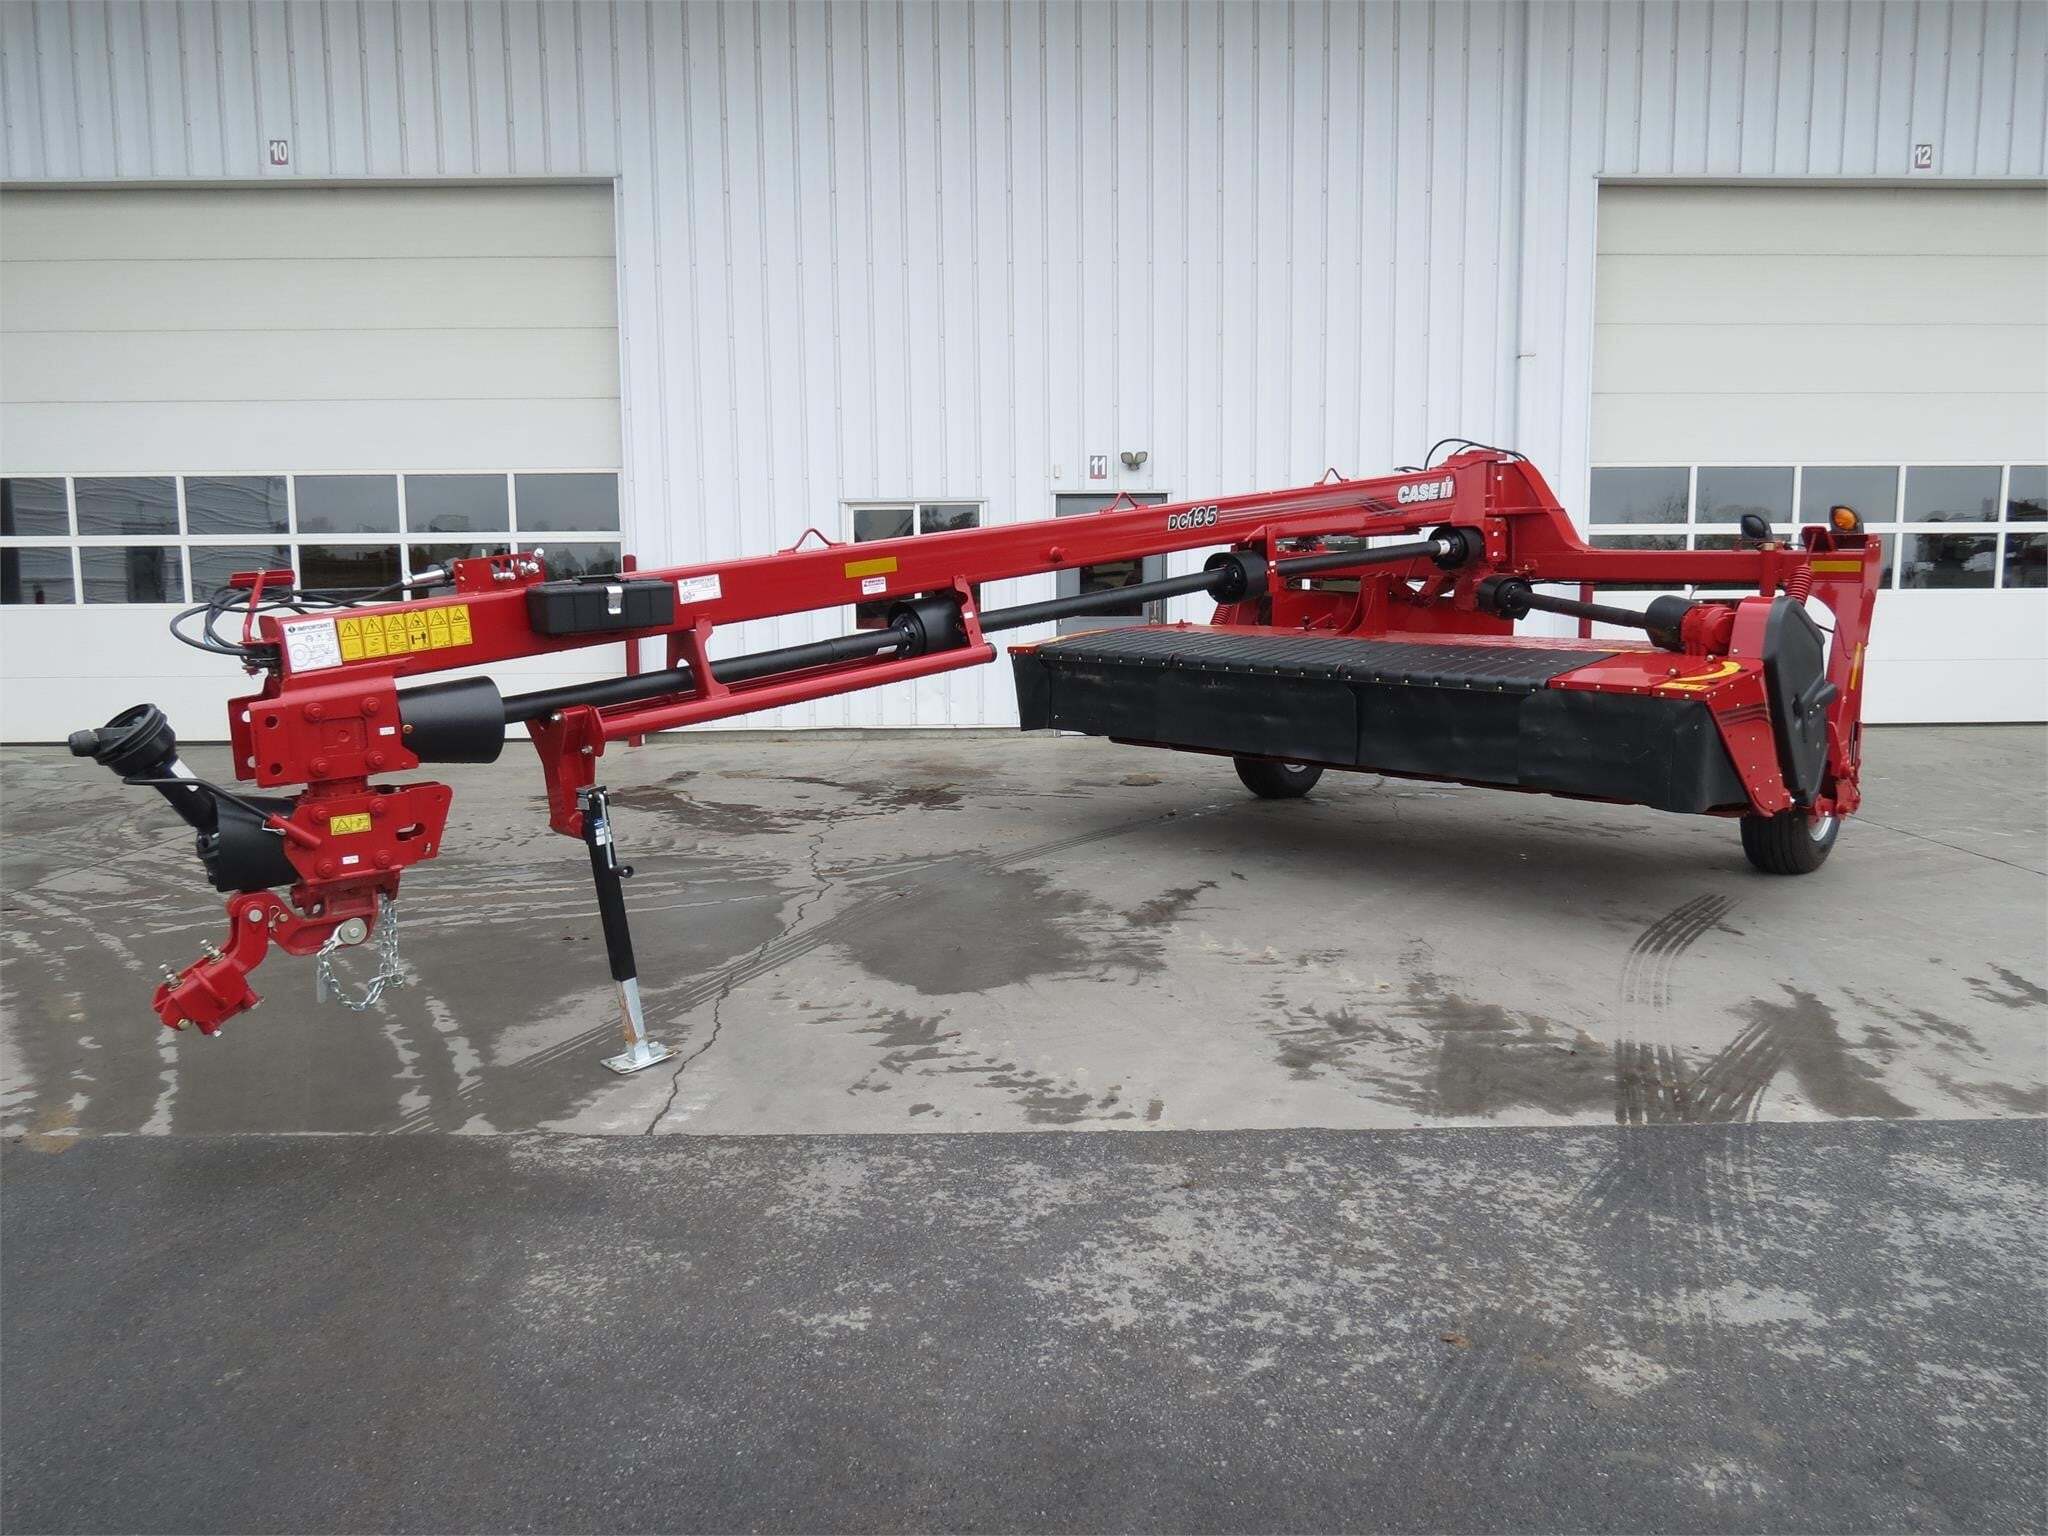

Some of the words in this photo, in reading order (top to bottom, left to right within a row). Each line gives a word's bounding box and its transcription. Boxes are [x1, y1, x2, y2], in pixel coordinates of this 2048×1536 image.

[270, 142, 287, 161] 10
[1915, 146, 1931, 165] 12
[1091, 456, 1106, 475] 11
[1398, 482, 1440, 503] CASE
[1167, 505, 1218, 531] DC135
